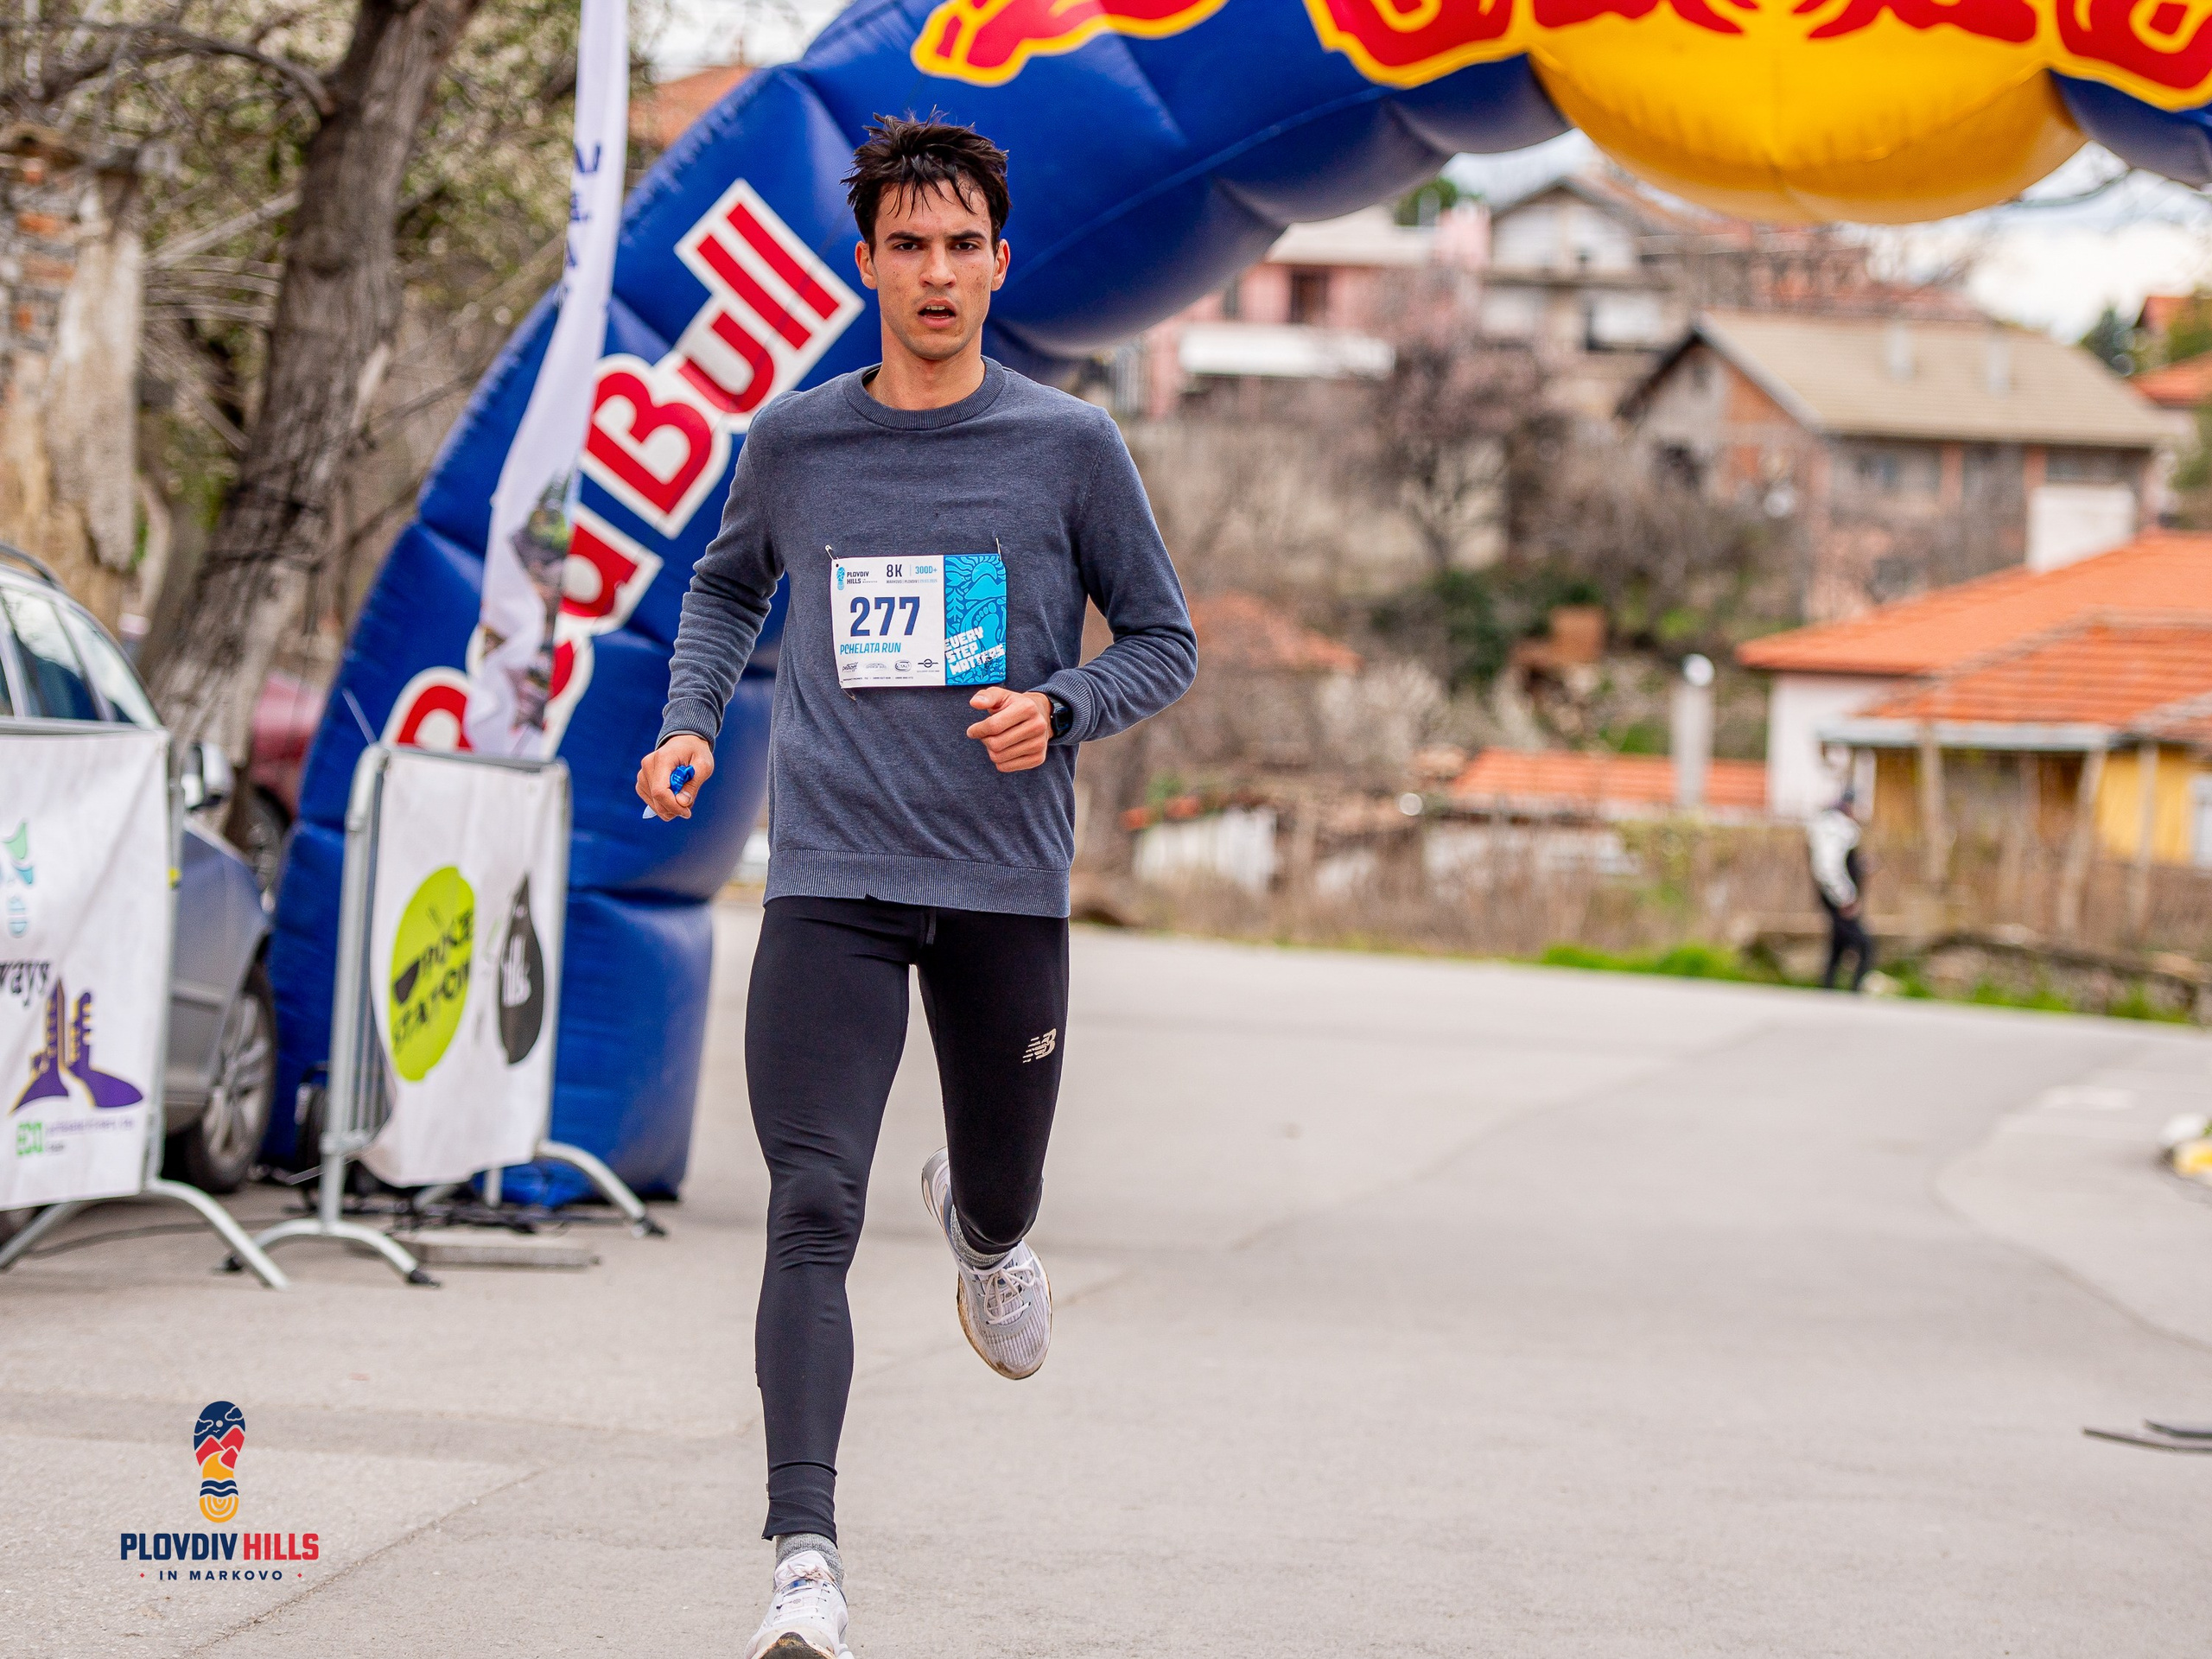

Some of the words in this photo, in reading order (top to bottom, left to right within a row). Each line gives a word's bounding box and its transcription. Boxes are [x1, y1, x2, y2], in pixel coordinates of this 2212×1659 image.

[582, 195, 851, 525] Bull
[887, 564, 903, 578] 8K
[850, 596, 920, 637] 277
[840, 642, 880, 655] PCHELATA
[881, 642, 901, 653] RUN
[944, 626, 984, 652] EVERY
[945, 641, 979, 664] STEP
[949, 643, 1006, 676] MATTERS
